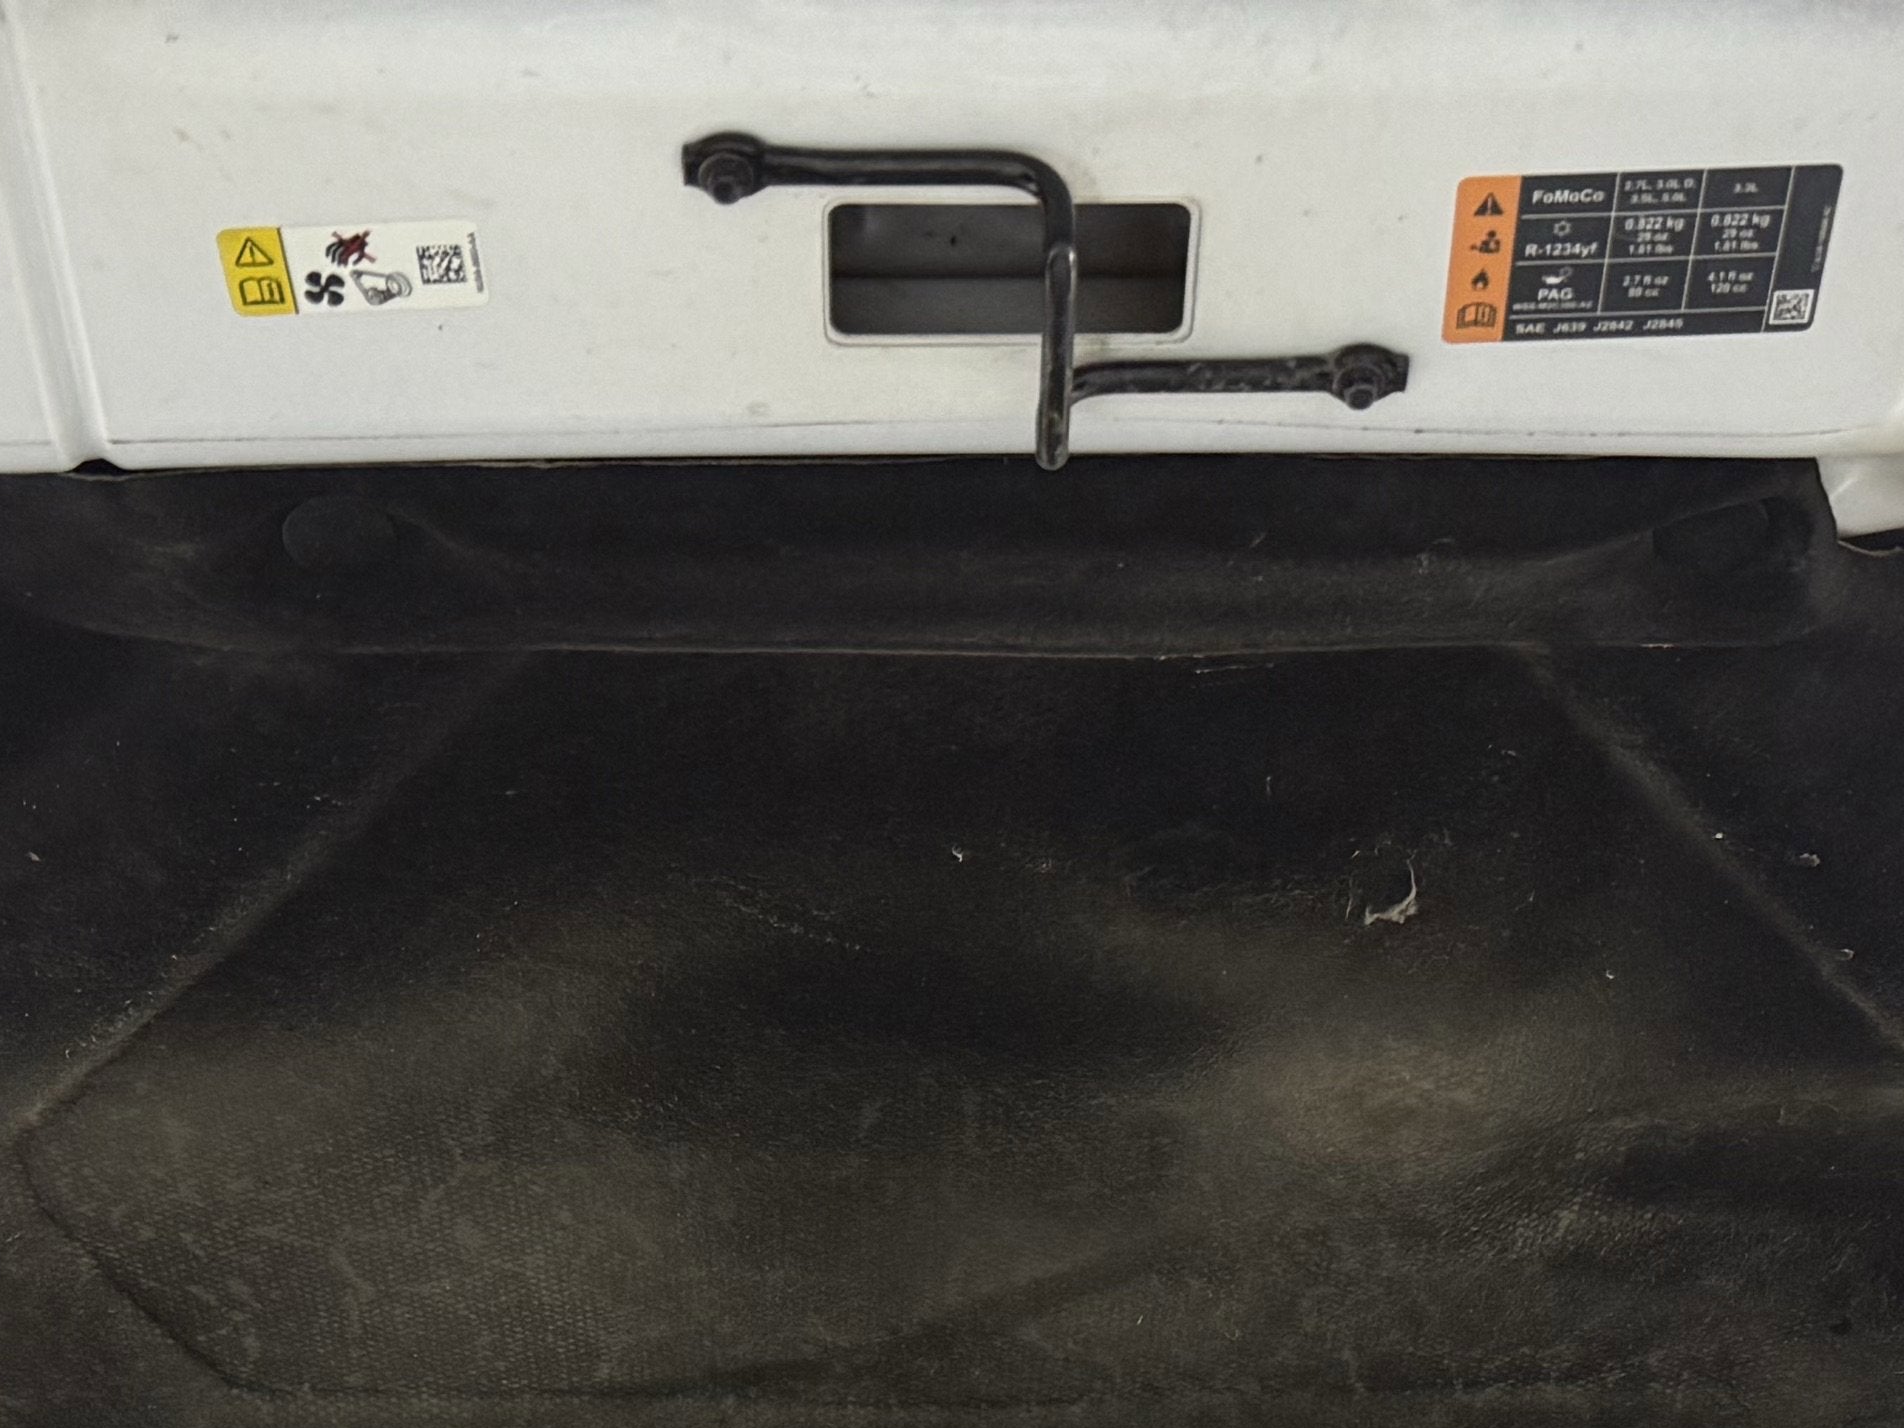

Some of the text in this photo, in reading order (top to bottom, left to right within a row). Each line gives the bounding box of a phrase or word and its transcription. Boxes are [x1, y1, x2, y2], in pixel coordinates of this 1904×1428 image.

[1532, 188, 1606, 204] FoMoCo
[1666, 216, 1686, 232] kg
[1752, 213, 1771, 229] kg
[1524, 241, 1600, 258] R-1234yf
[1537, 287, 1574, 301] PAG
[1515, 322, 1546, 335] SAE
